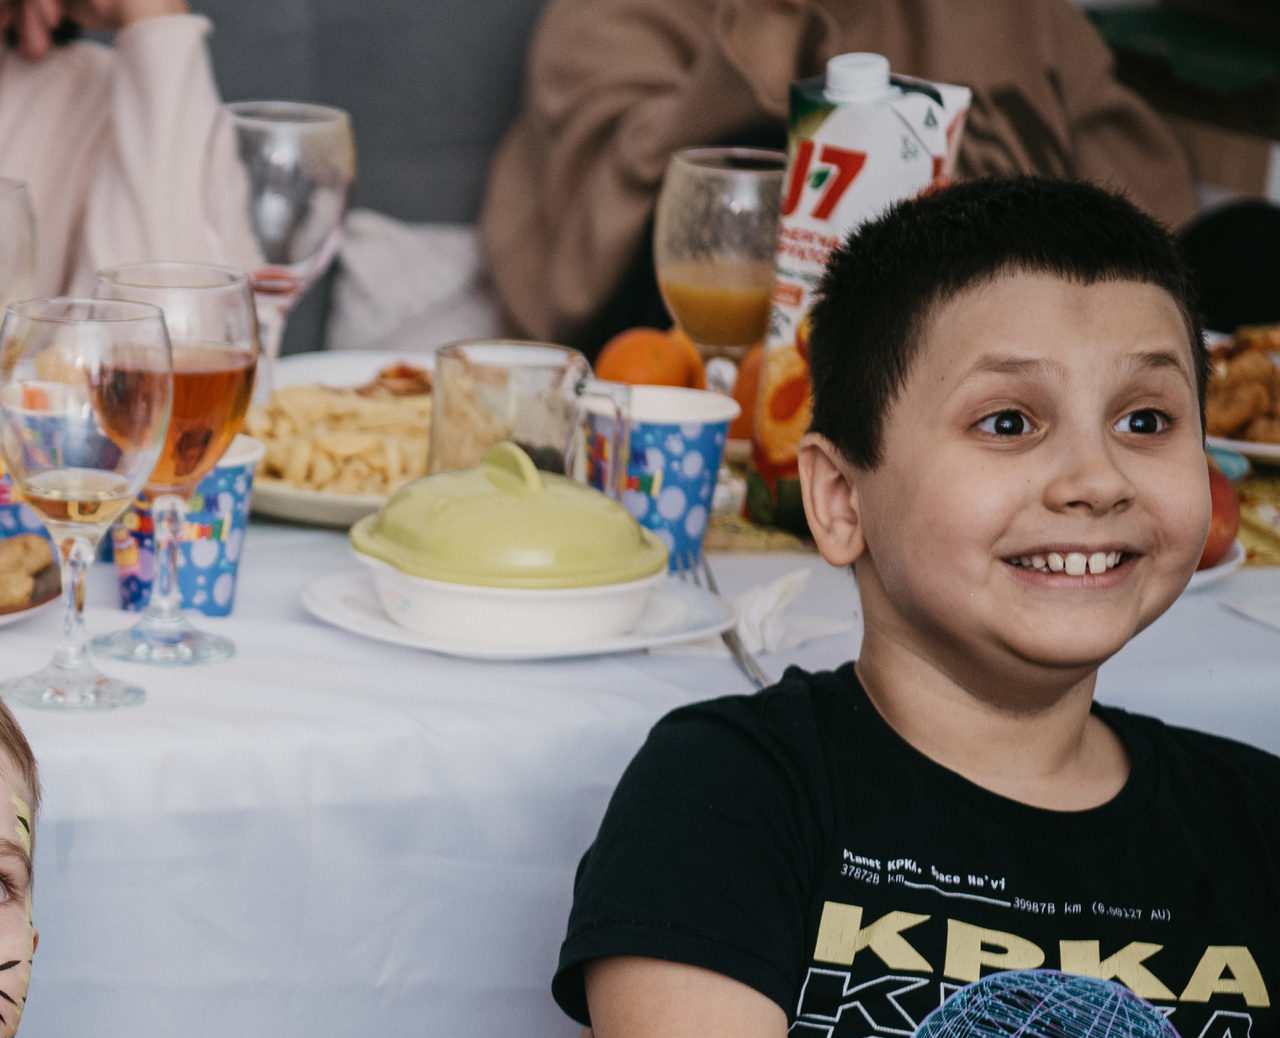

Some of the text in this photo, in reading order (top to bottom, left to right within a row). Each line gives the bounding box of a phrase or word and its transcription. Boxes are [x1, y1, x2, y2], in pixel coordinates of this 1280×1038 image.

[843, 848, 882, 870] Planet
[967, 874, 1006, 891] Na'vi
[887, 873, 905, 885] km
[1064, 901, 1082, 915] km
[1150, 908, 1172, 922] AU)
[813, 900, 1270, 1008] KPKA
